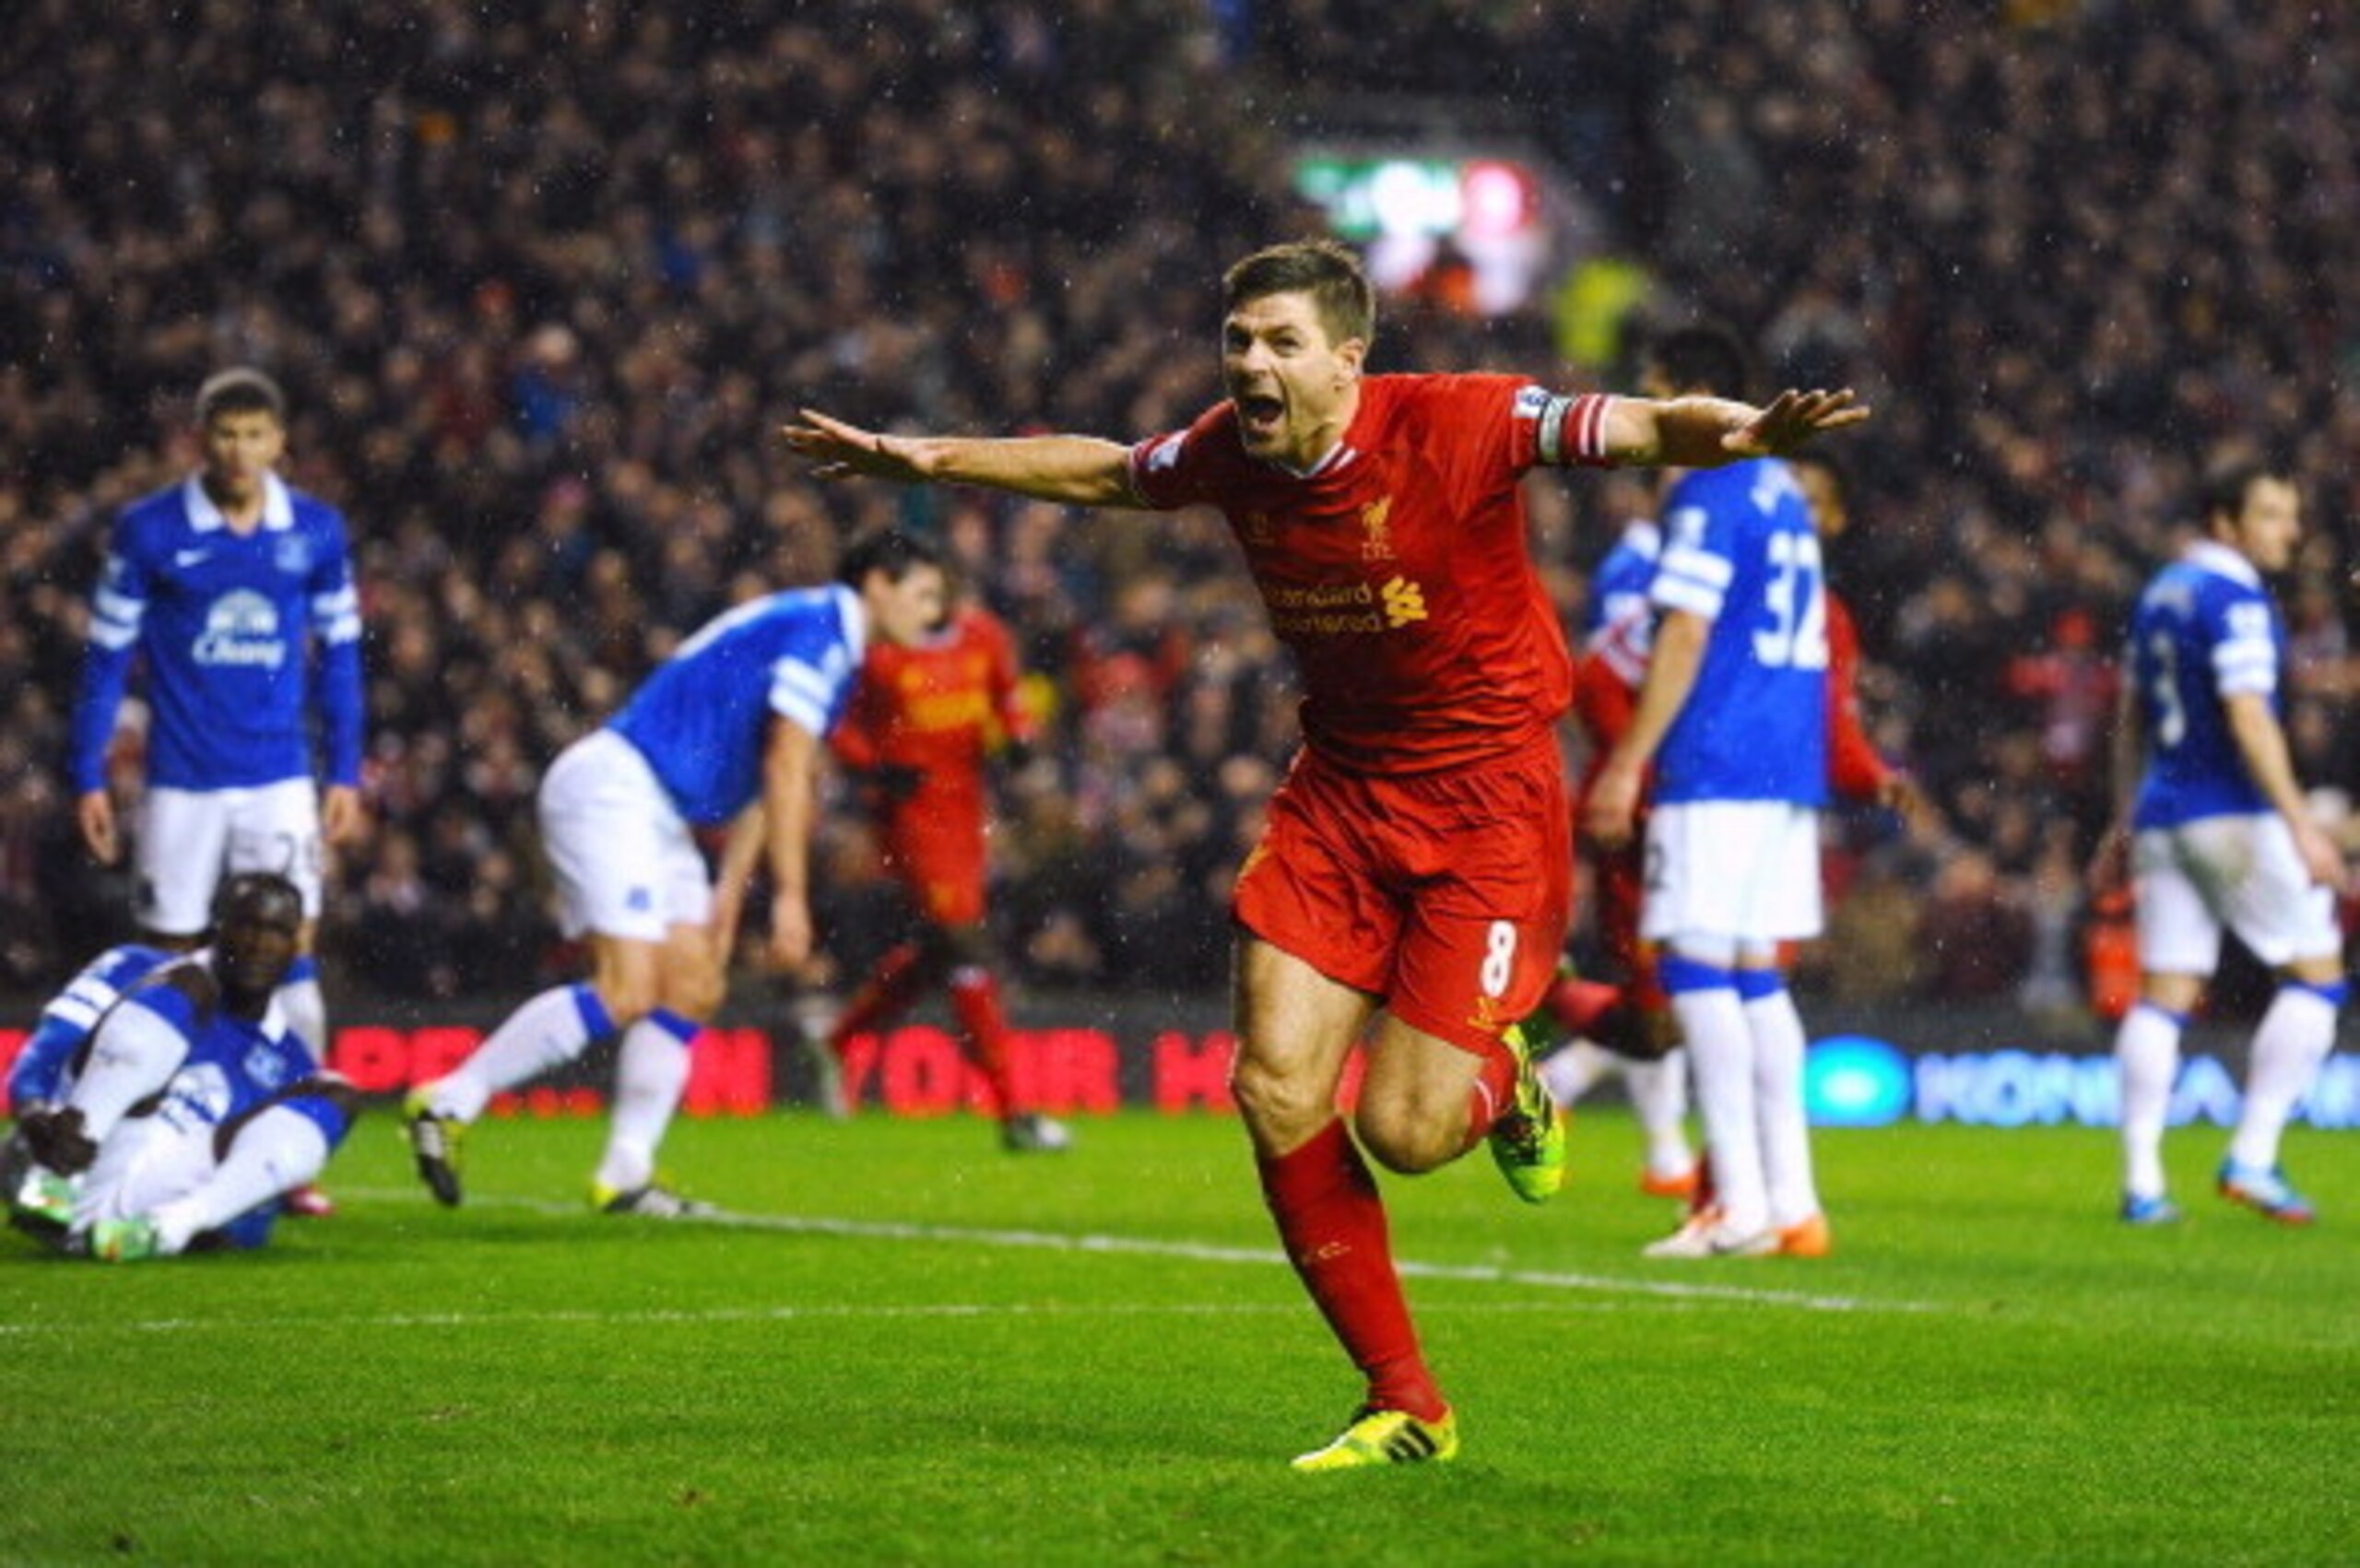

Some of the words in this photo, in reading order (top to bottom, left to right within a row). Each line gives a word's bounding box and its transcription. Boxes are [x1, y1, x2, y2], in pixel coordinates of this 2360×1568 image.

[1752, 529, 1830, 668] 32
[1481, 919, 1517, 998] 8
[1915, 1048, 2244, 1127] KONIA
